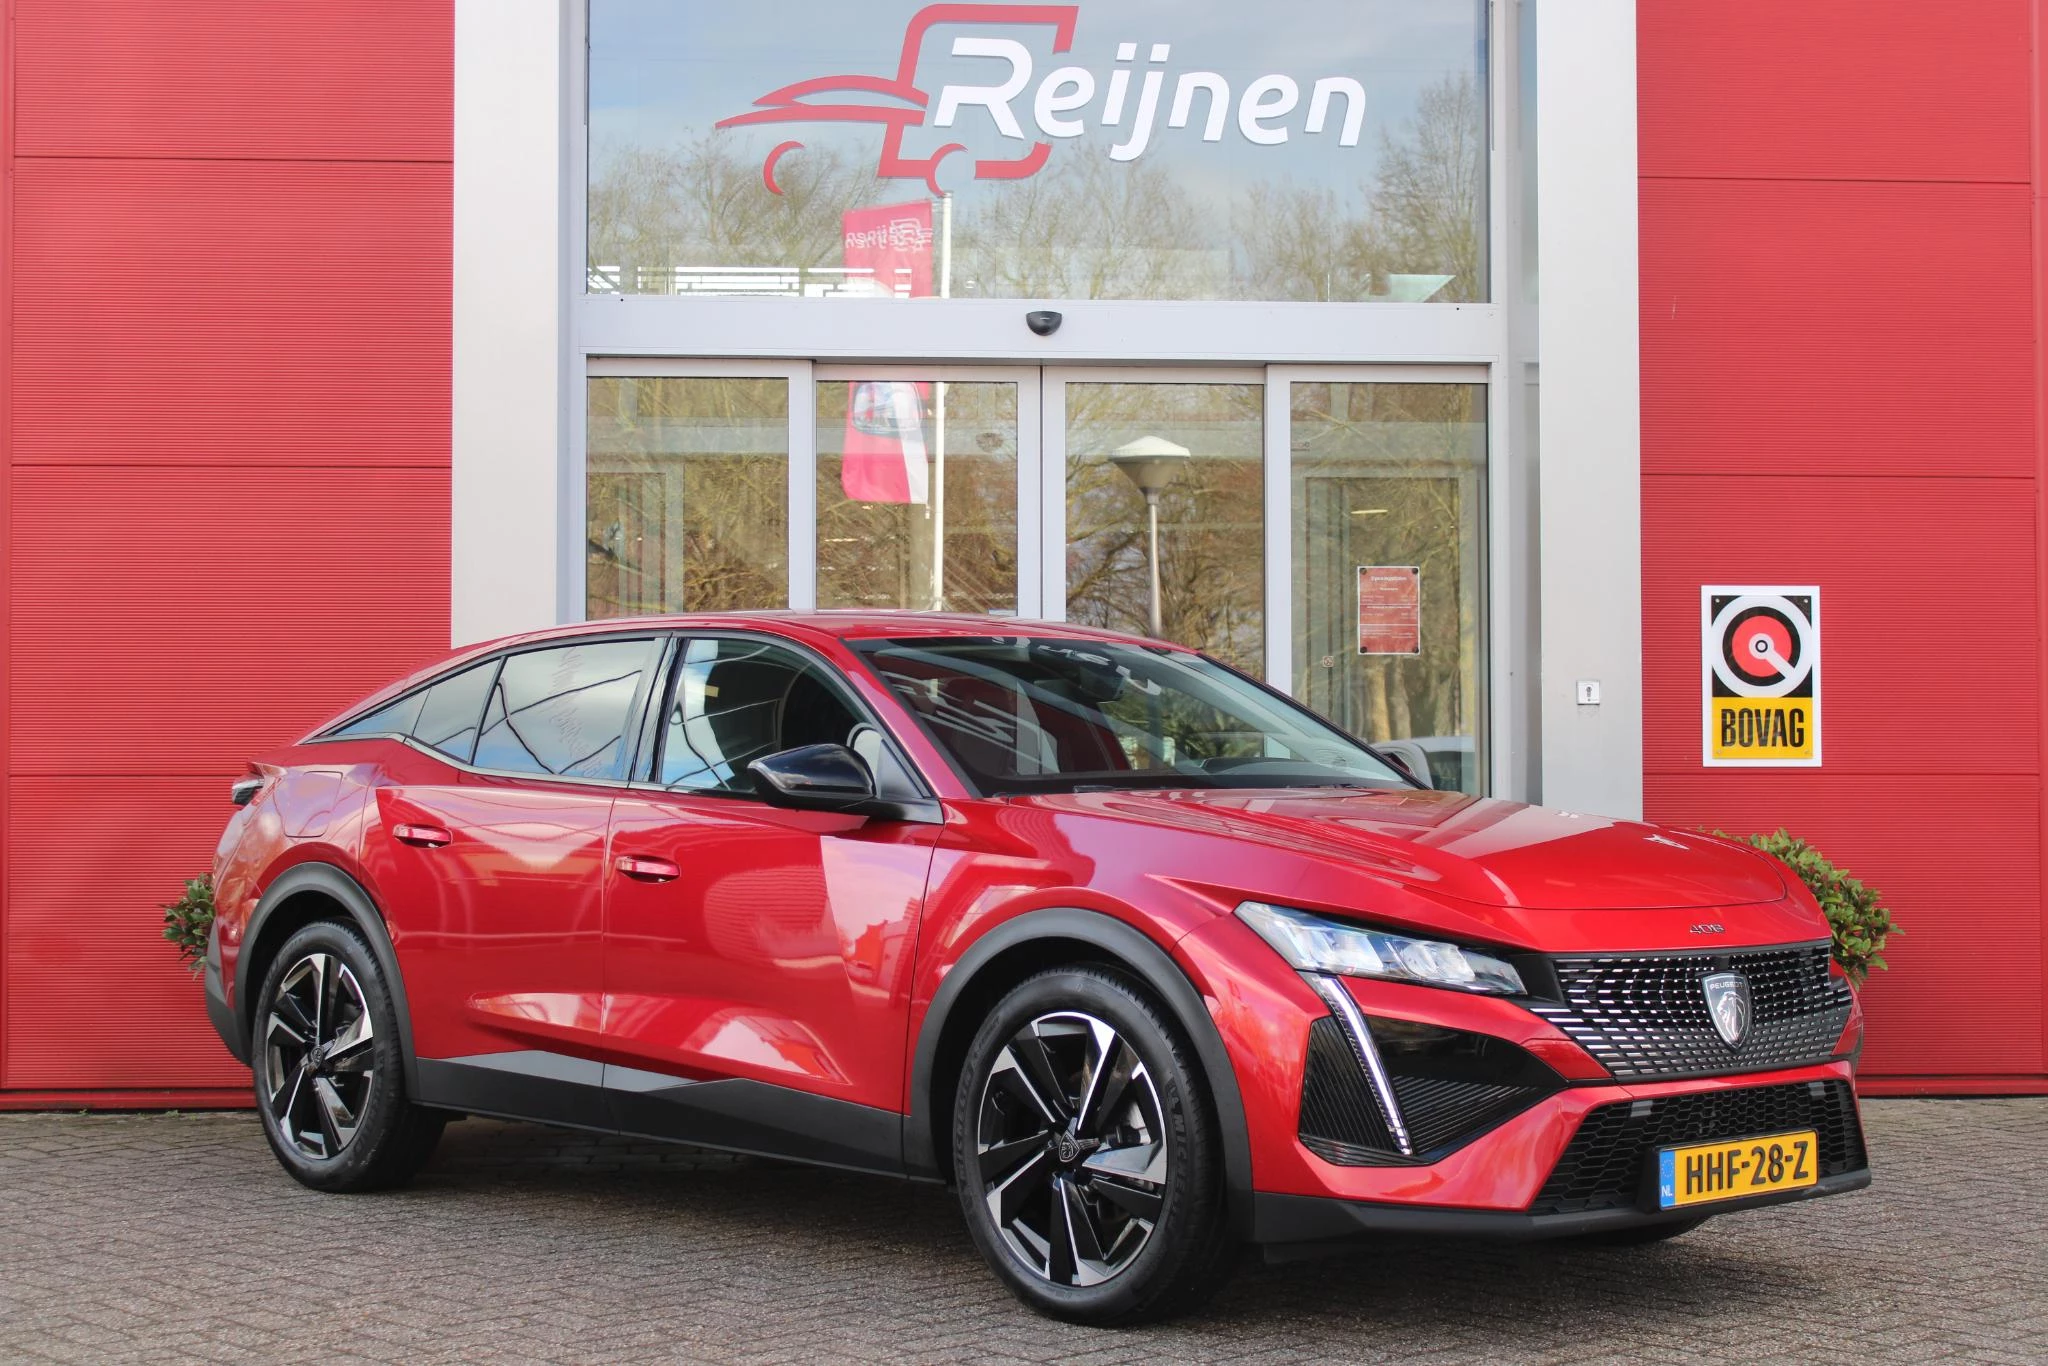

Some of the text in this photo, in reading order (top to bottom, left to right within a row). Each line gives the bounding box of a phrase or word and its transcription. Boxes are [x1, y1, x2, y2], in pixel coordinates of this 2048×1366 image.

[933, 37, 1366, 162] Reijnen
[1721, 708, 1804, 747] BOVAG
[1709, 981, 1744, 990] PEUGEOT
[1686, 1141, 1808, 1195] HHF-28-Z
[1661, 1184, 1673, 1197] NL
